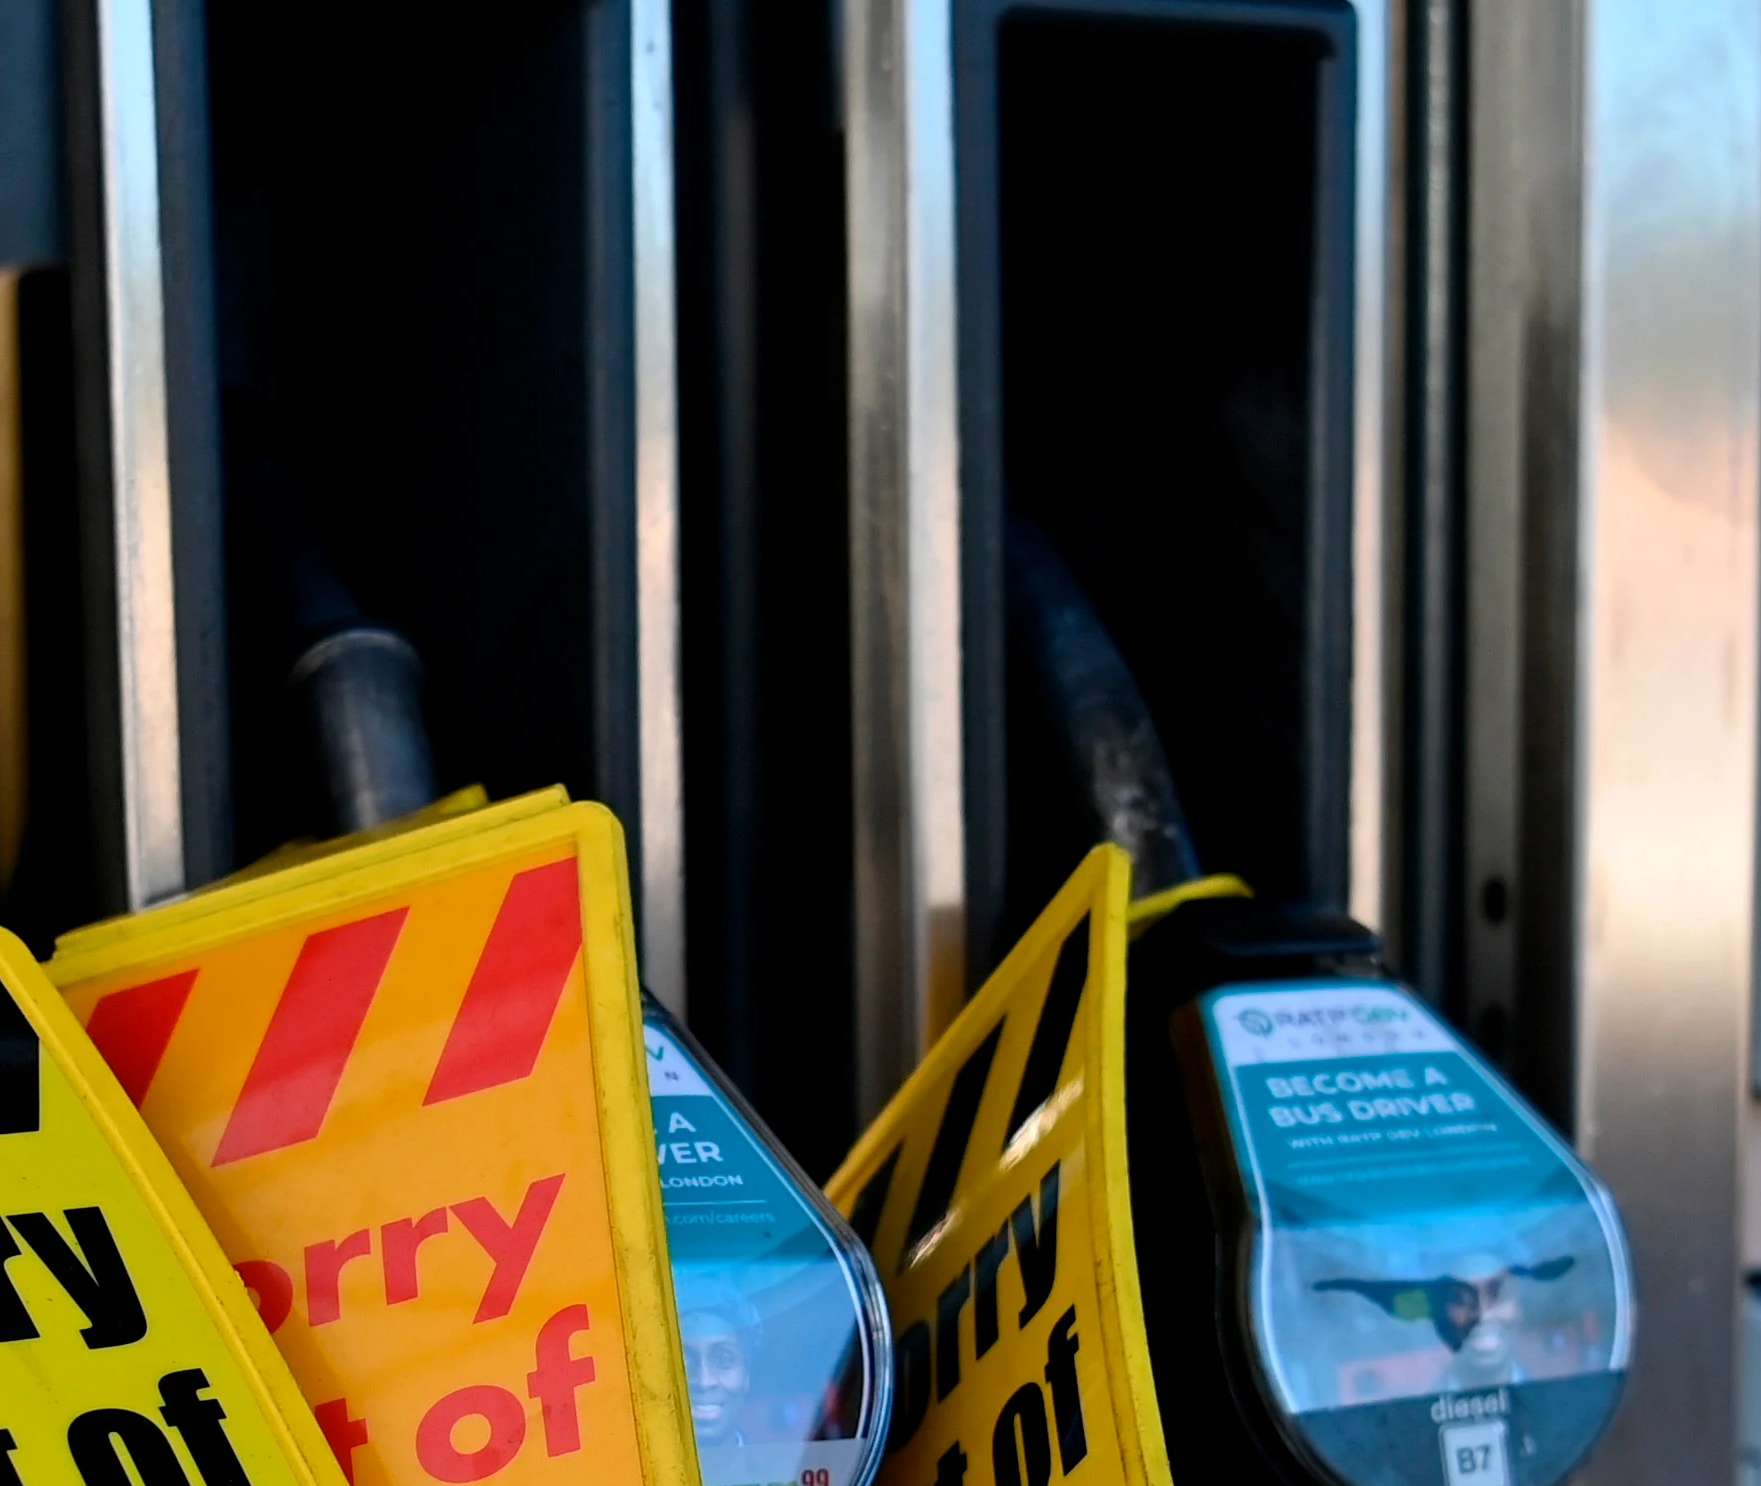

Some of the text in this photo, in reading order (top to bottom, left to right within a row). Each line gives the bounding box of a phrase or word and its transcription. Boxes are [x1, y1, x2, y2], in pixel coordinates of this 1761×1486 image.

[1265, 1065, 1448, 1099] BECOME A
[668, 1111, 697, 1134] A
[1268, 1092, 1476, 1128] BUS DRIVER
[659, 1173, 744, 1189] LONDON
[231, 1172, 566, 1336] orry
[893, 1159, 1061, 1452] orry
[415, 1303, 596, 1484] of
[1430, 1386, 1509, 1424] diesel
[1455, 1445, 1491, 1475] B7
